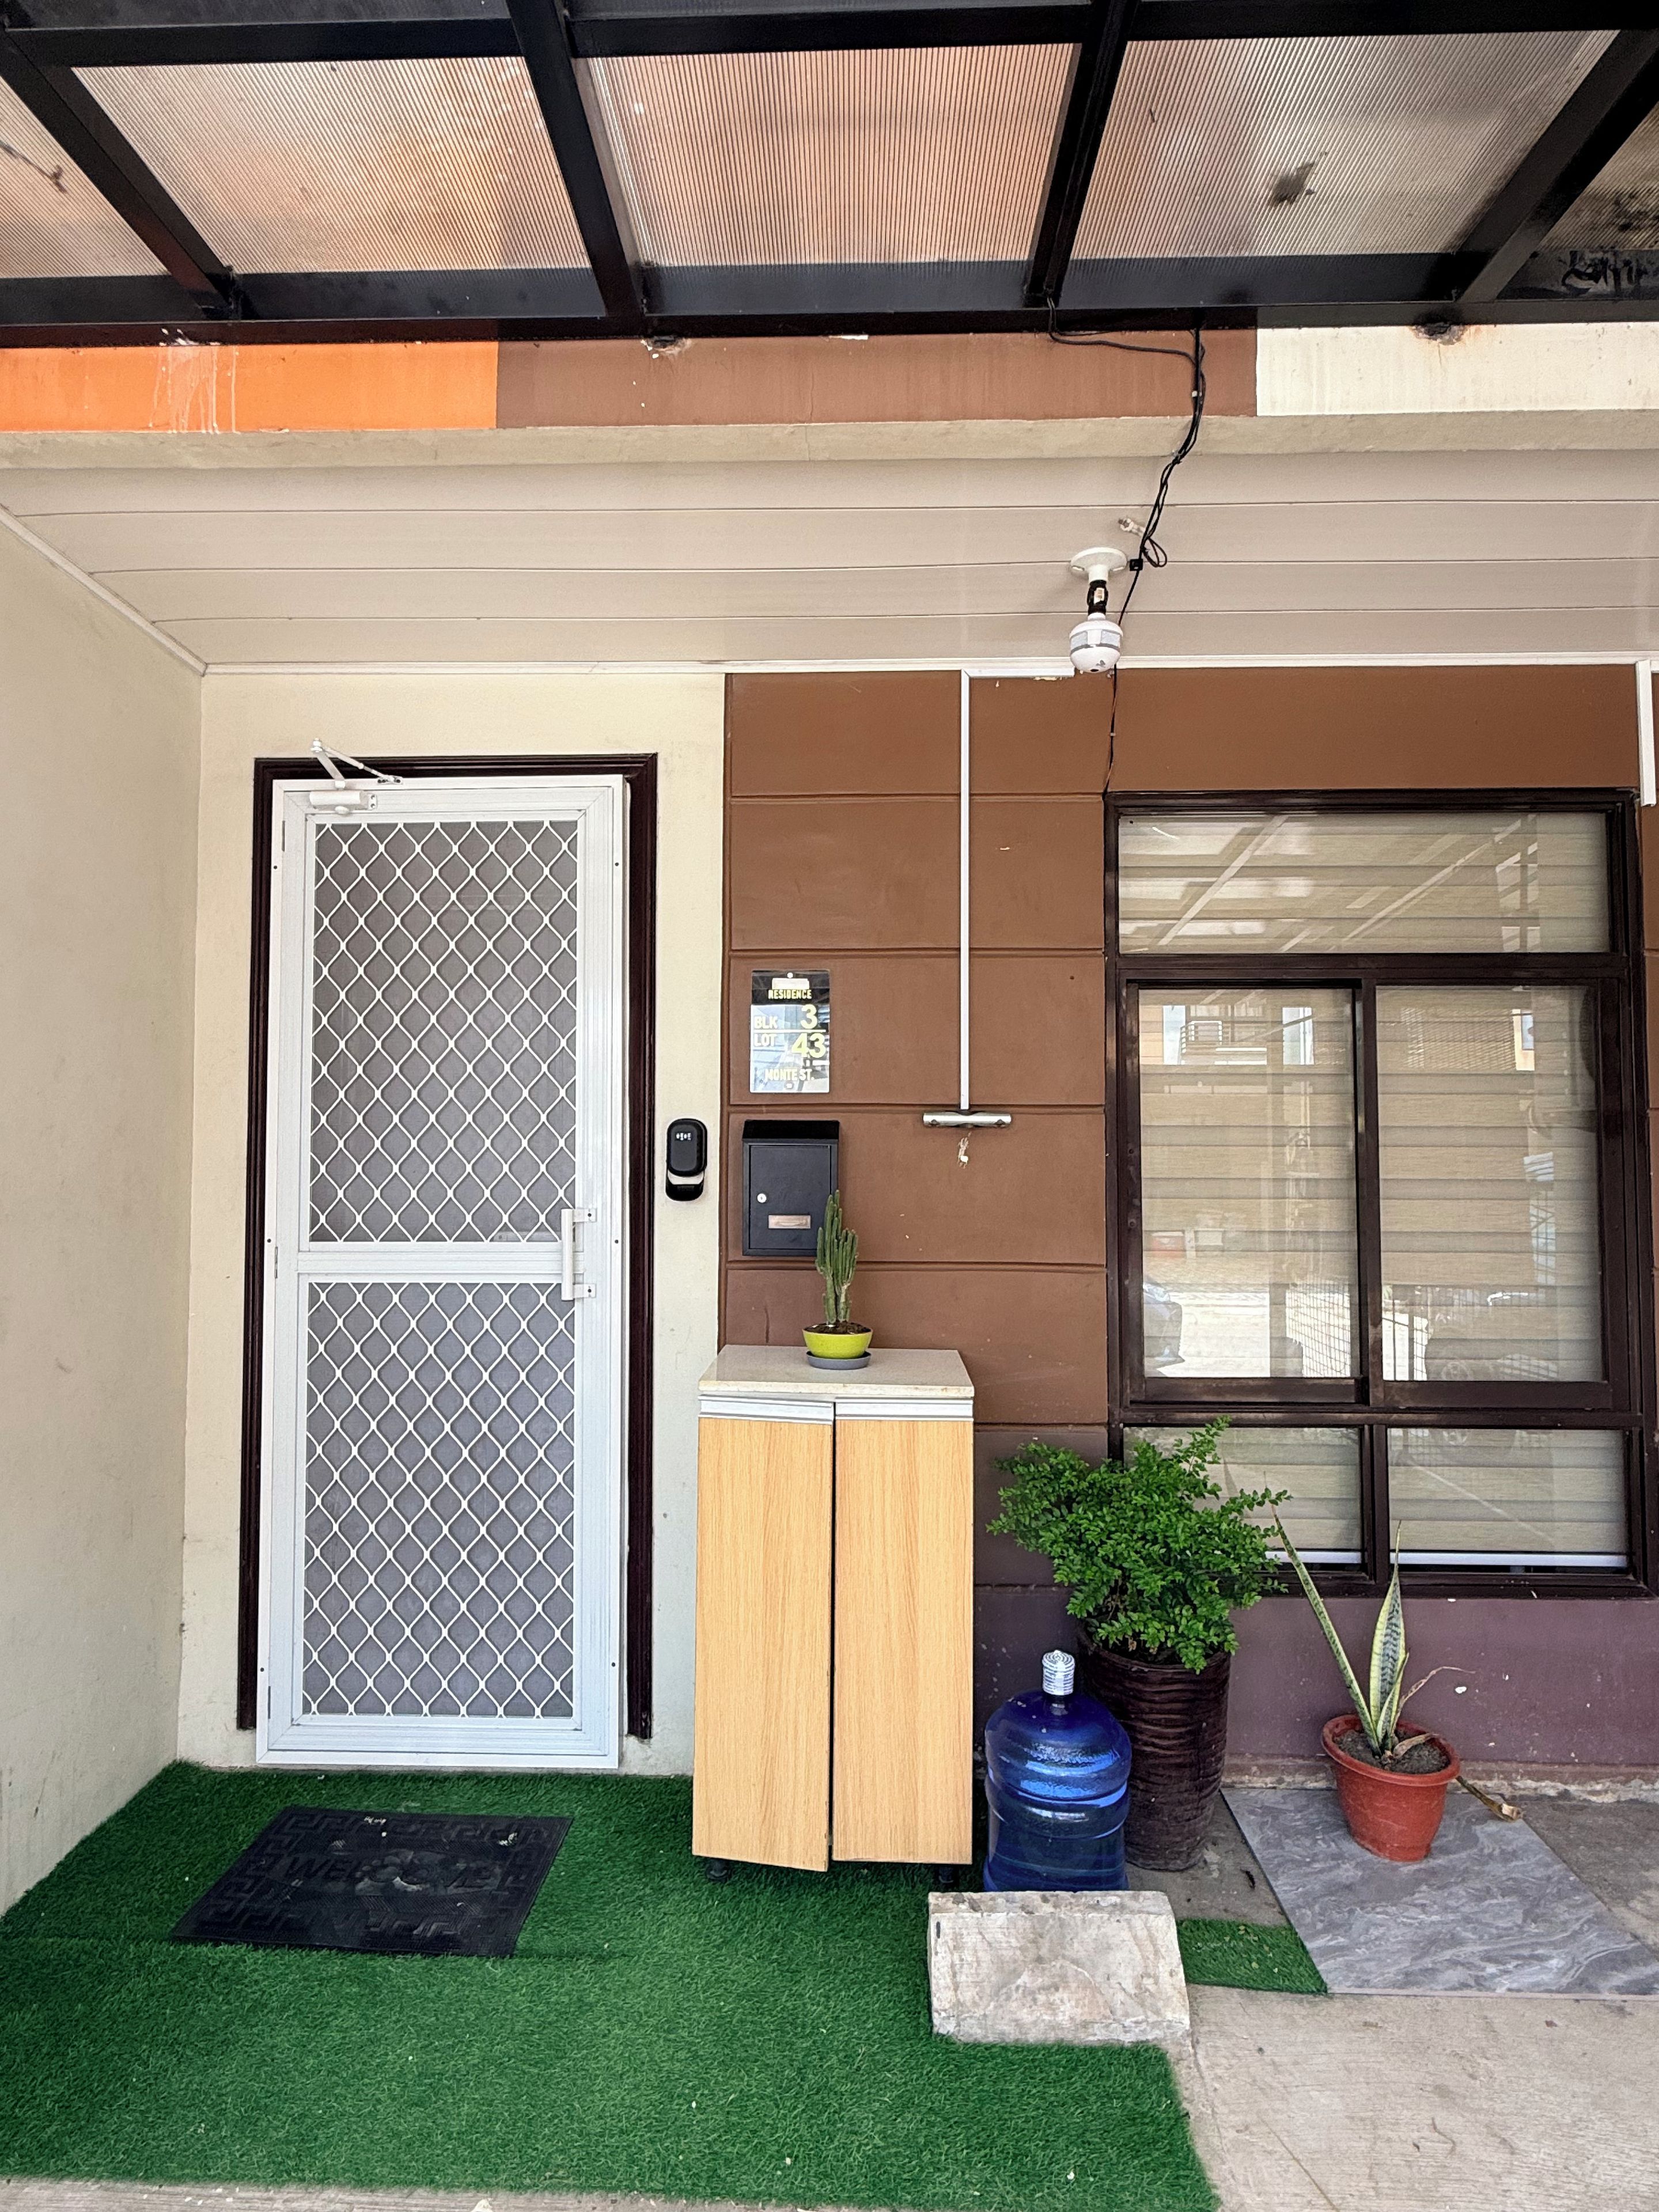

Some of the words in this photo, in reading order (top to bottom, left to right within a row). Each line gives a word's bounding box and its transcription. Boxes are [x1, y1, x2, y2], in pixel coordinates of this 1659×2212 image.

[768, 990, 812, 999] RESIDENCE
[754, 1016, 778, 1029] BLK
[801, 1004, 818, 1029] 3
[754, 1033, 776, 1047] LOT
[791, 1033, 827, 1058] 43
[765, 1069, 798, 1081] MONTE
[799, 1070, 815, 1081] ST.
